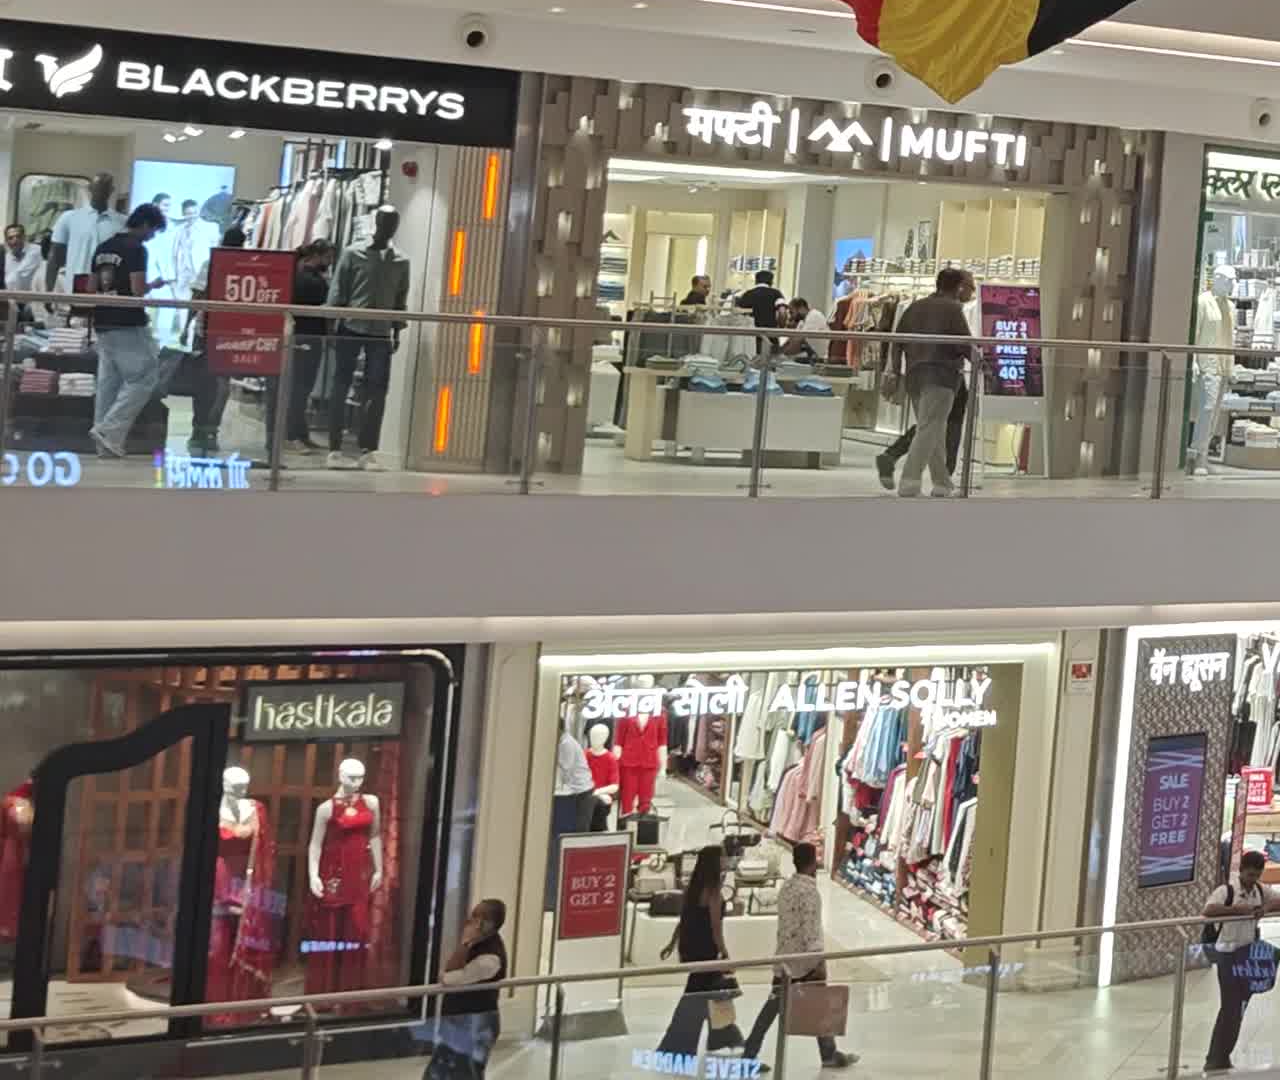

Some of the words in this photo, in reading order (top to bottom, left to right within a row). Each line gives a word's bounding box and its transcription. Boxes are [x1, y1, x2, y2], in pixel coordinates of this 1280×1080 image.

[116, 60, 466, 120] BLACKBERRYS
[900, 125, 1027, 167] MUFTI
[256, 289, 281, 303] OFF
[768, 680, 881, 713] ALLEN
[890, 675, 992, 710] SOLLY
[1160, 773, 1190, 790] SALE
[1153, 798, 1181, 813] BUY
[1182, 795, 1190, 809] 2
[1152, 813, 1179, 830] GET
[1180, 813, 1188, 827] 2
[1151, 829, 1187, 846] FREE
[571, 875, 603, 890] BUY
[604, 873, 617, 888] 2
[569, 891, 601, 906] GET
[603, 890, 616, 904] 2
